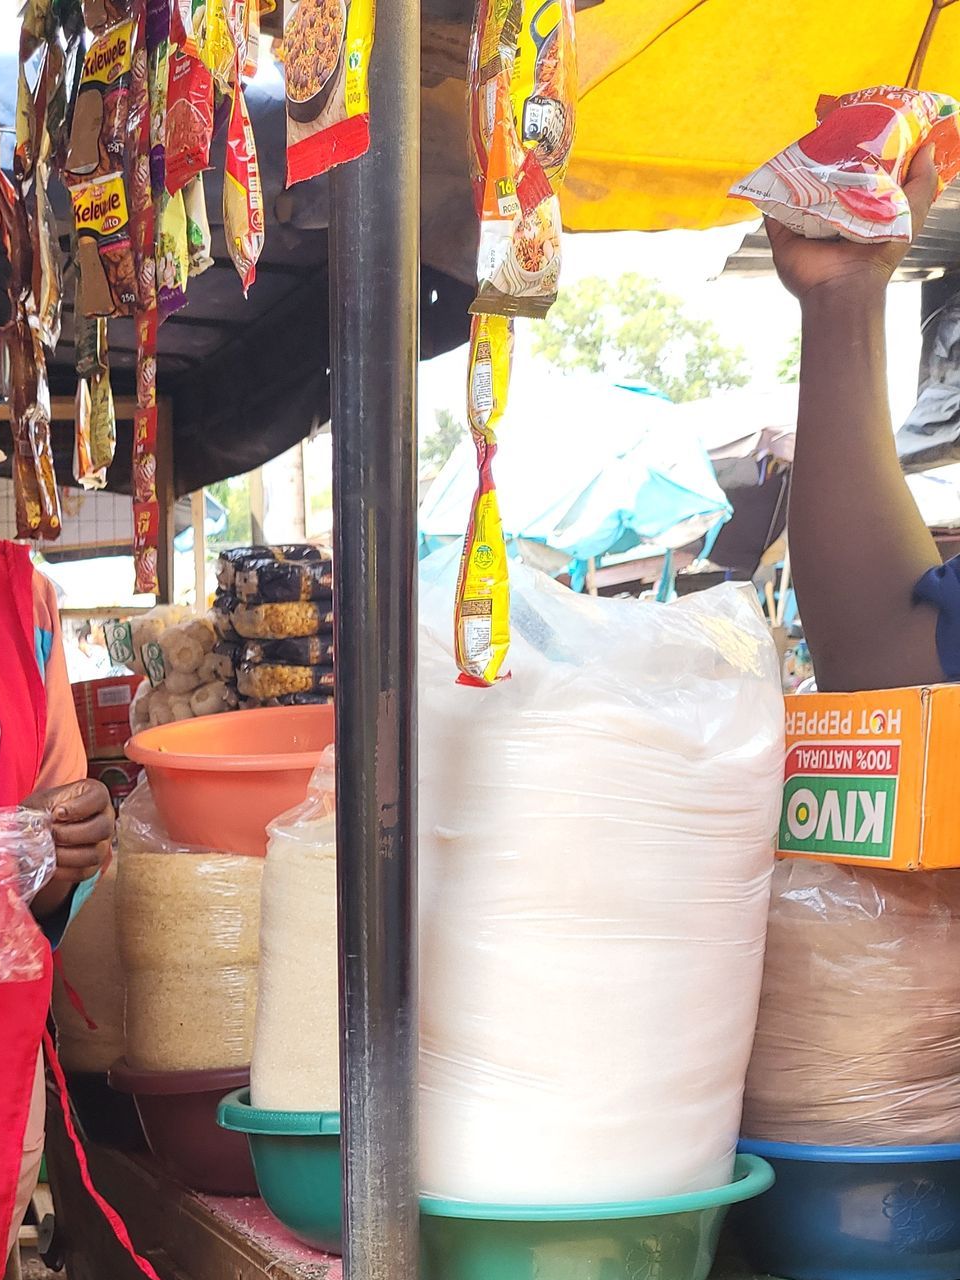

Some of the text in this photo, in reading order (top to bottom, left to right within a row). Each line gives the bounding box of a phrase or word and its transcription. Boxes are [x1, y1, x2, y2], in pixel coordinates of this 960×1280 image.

[856, 708, 902, 735] HOT
[795, 749, 892, 771] 100% NATURAL
[787, 788, 887, 844] KIVO
